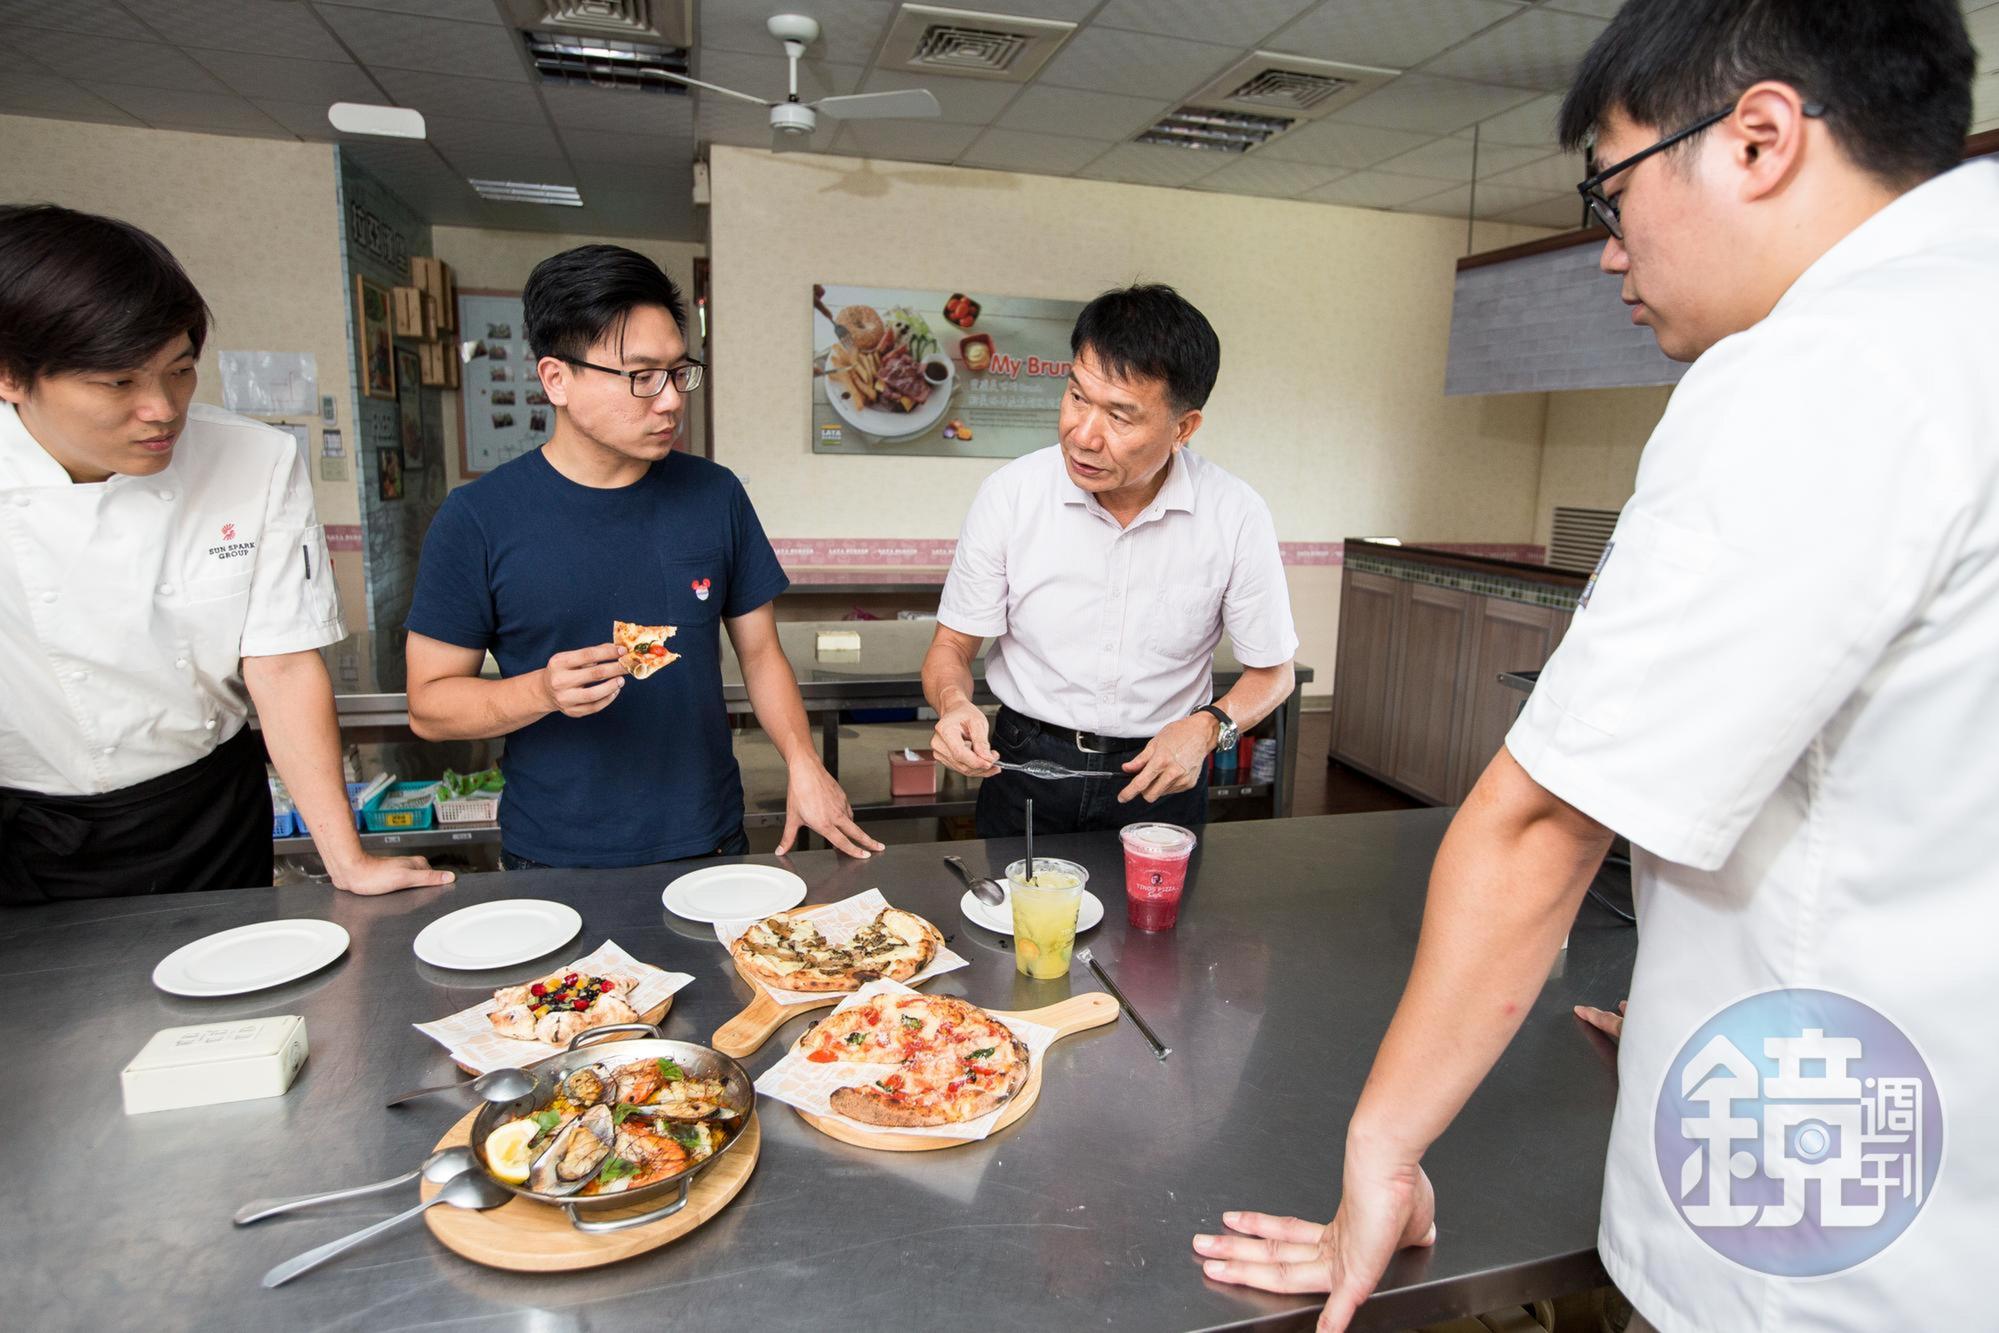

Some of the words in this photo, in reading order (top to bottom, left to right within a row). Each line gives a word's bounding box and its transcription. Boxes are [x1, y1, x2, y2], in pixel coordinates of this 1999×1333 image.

[990, 354, 1021, 378] My
[208, 546, 226, 555] SUN
[228, 542, 255, 551] SPARK
[218, 550, 249, 560] GROUP
